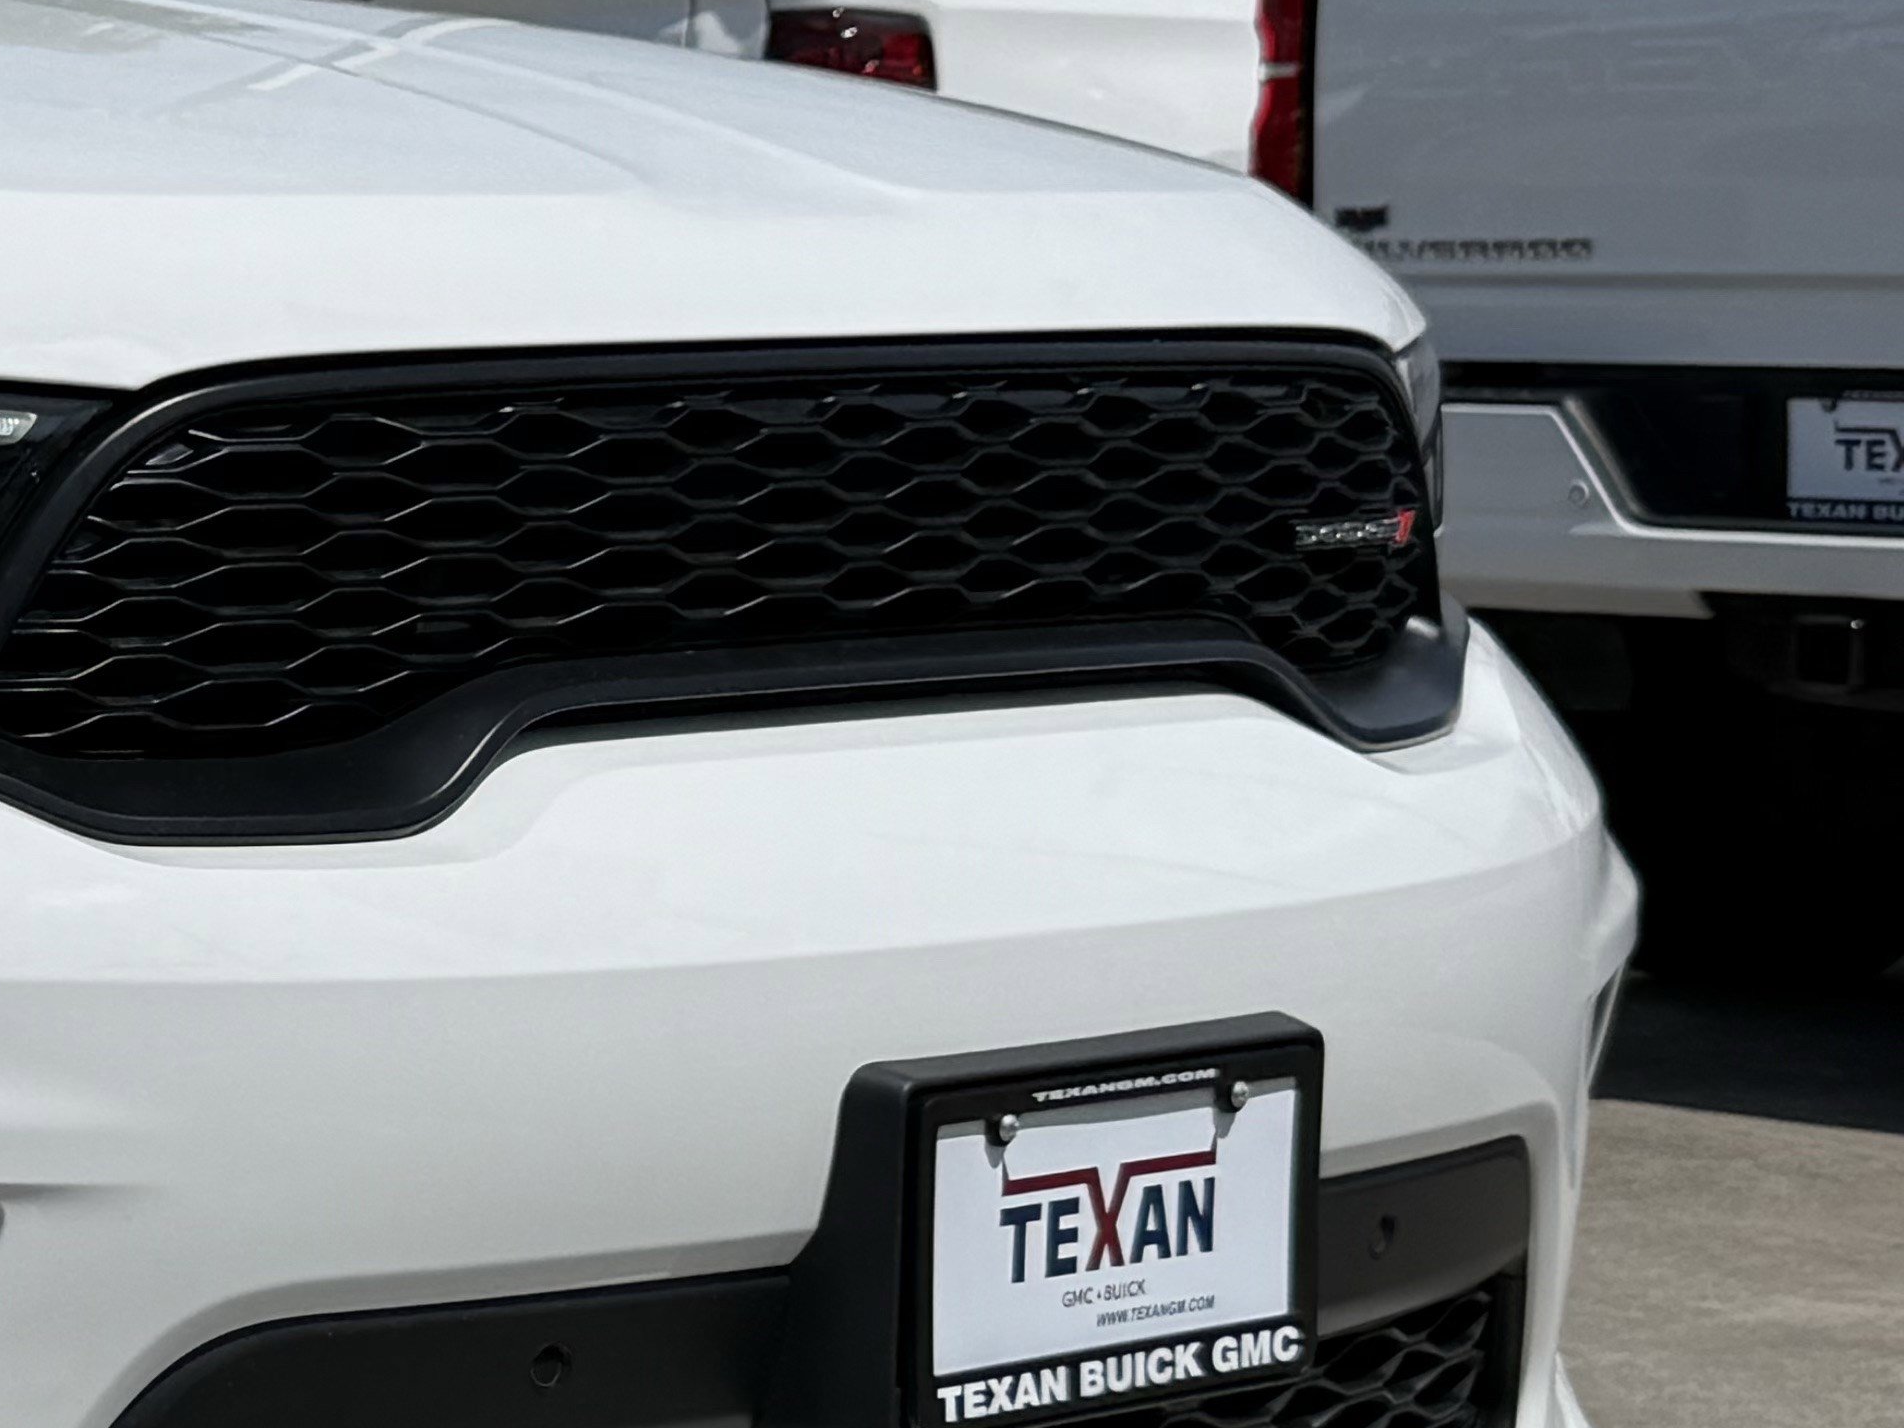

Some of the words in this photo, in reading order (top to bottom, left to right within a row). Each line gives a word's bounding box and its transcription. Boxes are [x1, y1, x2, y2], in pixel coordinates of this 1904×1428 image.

[1032, 1068, 1220, 1102] TEXANGM.COM
[999, 1151, 1217, 1284] TEXAN
[1062, 1287, 1094, 1308] GMC
[1103, 1279, 1146, 1301] BUICK
[1096, 1294, 1215, 1327] WWW.TEXANGM.COM
[937, 1366, 1070, 1422] TEXAN
[1080, 1341, 1203, 1397] BUICK
[1211, 1325, 1304, 1373] GMC
